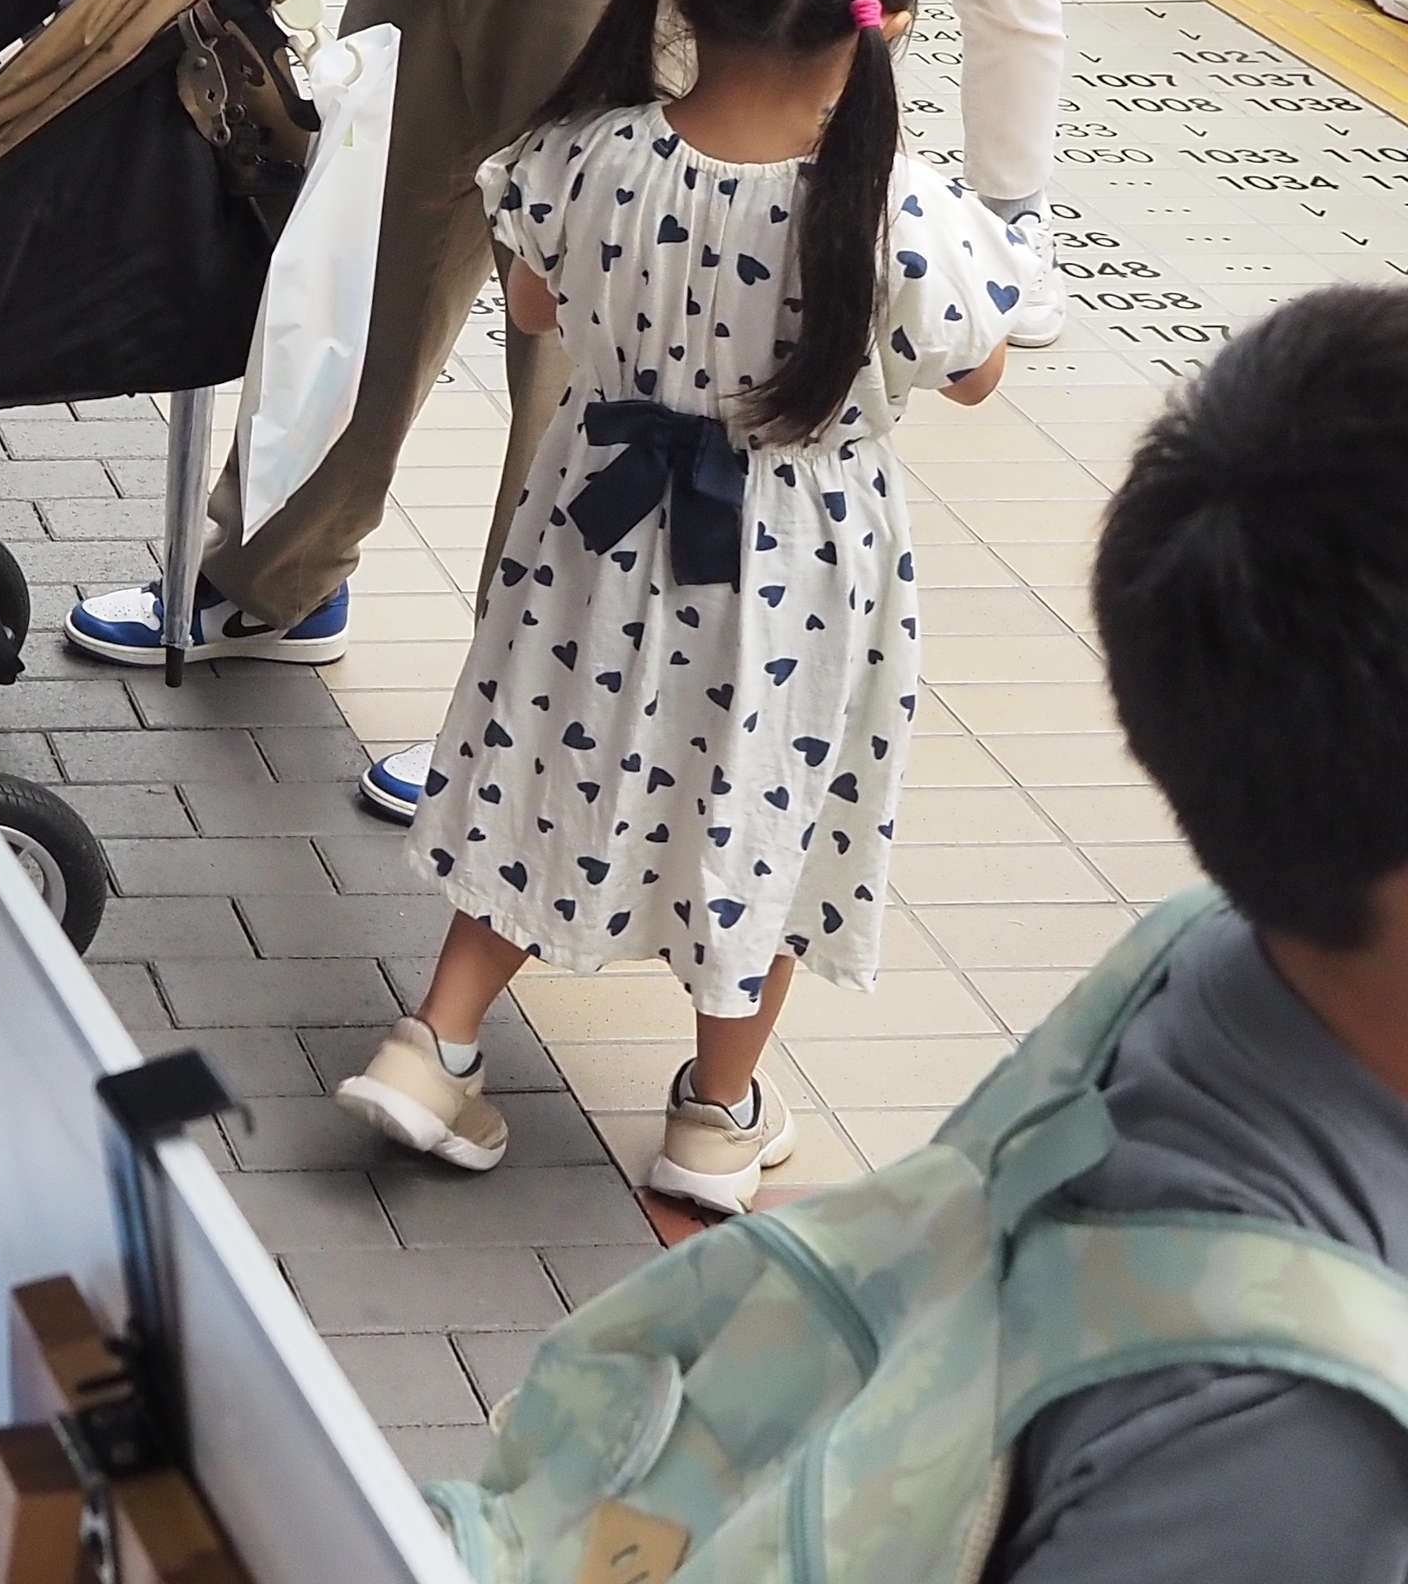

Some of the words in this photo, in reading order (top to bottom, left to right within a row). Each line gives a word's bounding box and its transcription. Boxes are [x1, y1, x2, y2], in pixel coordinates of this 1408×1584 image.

[1172, 50, 1283, 64] 1021
[1071, 73, 1178, 88] 1007
[1208, 73, 1319, 88] 1037
[1106, 97, 1224, 113] 1008
[1244, 97, 1363, 113] 1038
[1179, 148, 1300, 164] 1033
[1217, 175, 1340, 191] 1034
[1057, 261, 1161, 279] 048
[1069, 292, 1203, 311] 1058
